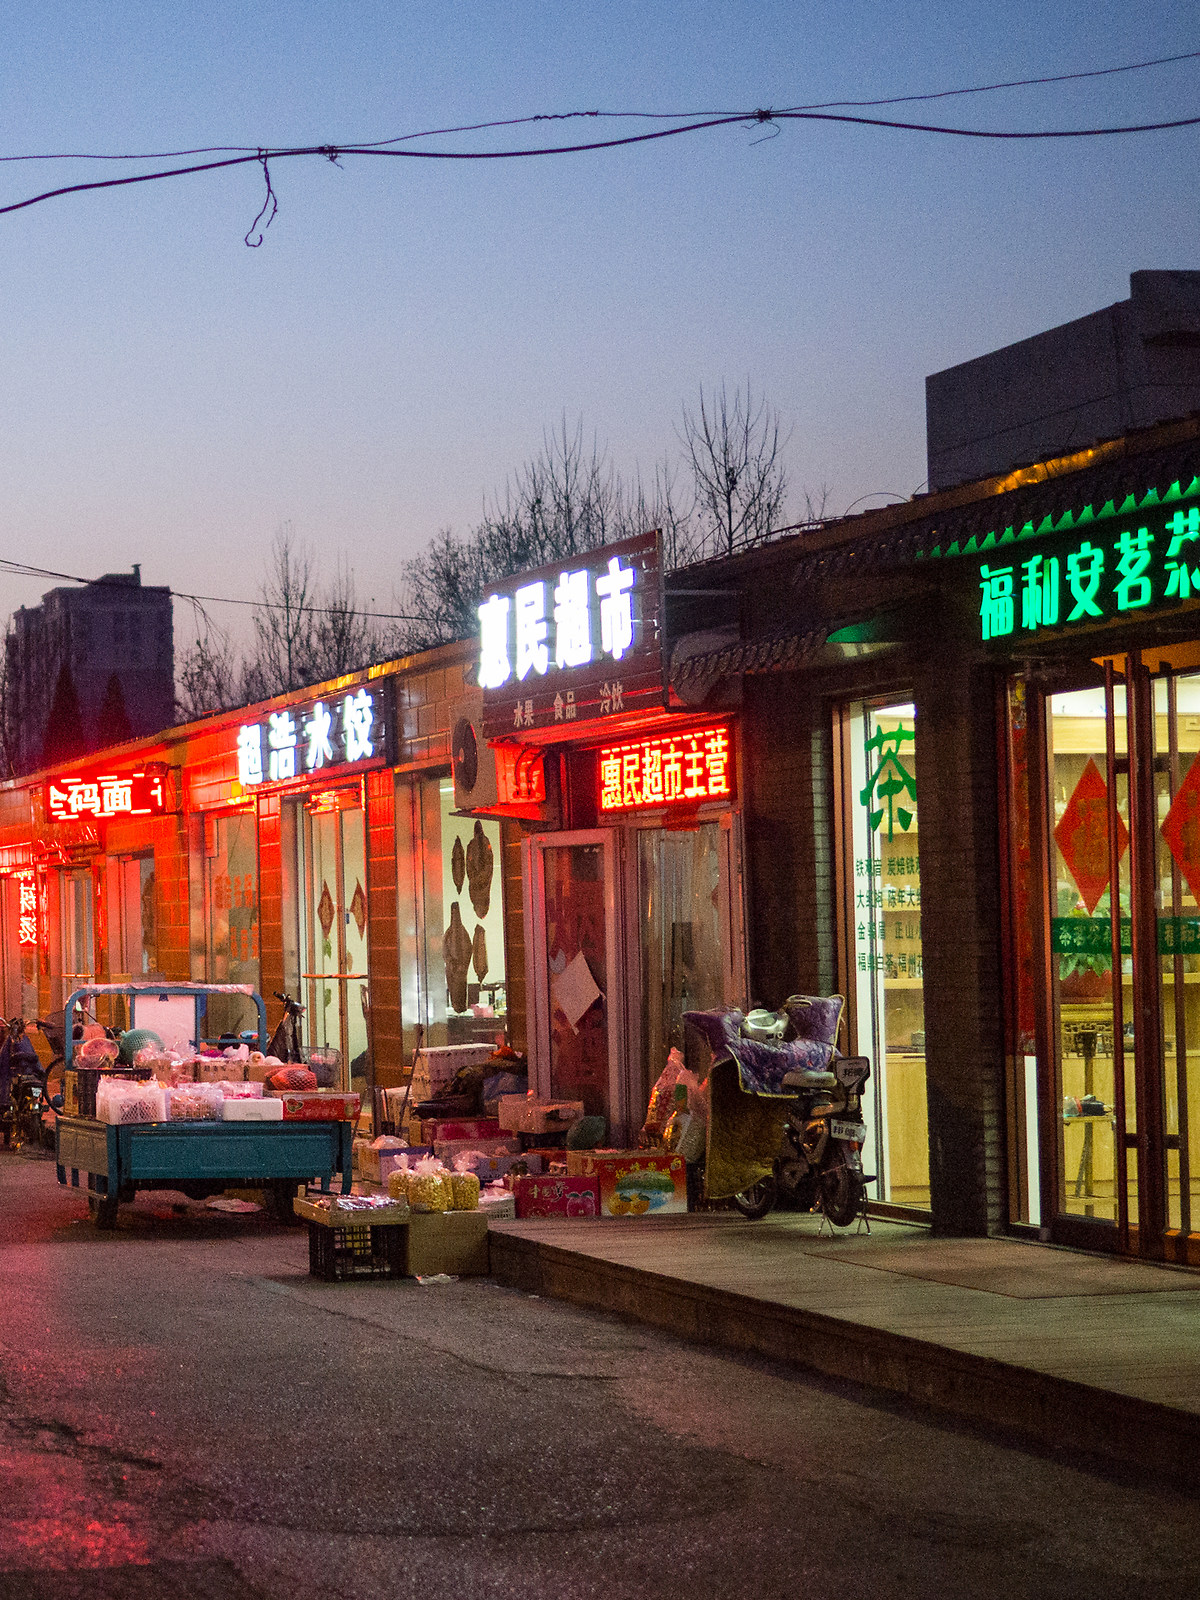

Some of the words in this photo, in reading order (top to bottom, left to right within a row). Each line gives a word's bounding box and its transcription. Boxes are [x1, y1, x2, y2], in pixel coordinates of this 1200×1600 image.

[478, 556, 636, 688] 惠民超市
[514, 700, 535, 727] 水果
[554, 691, 577, 720] 食品
[599, 681, 624, 713] 冷饮
[601, 737, 730, 810] 惠民超市主营
[859, 720, 917, 843] 茶
